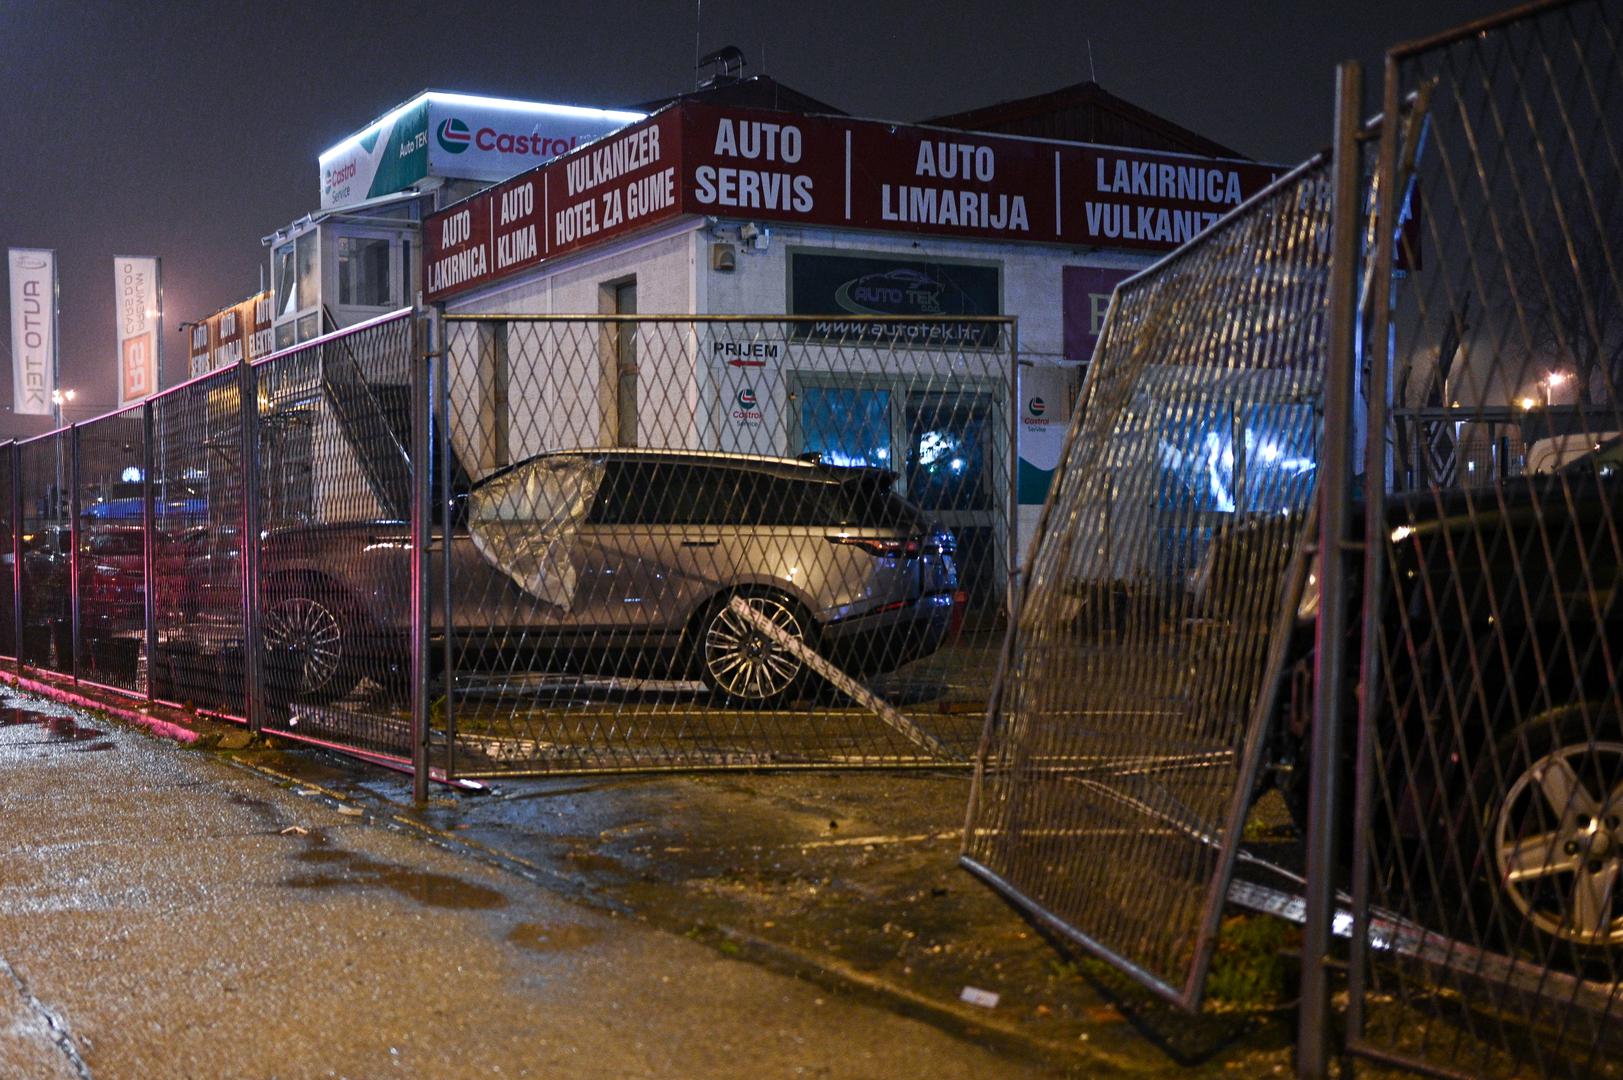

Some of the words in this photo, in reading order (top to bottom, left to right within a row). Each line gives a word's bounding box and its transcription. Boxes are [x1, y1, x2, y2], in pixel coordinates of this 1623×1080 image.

[400, 140, 415, 158] Auto
[415, 130, 428, 150] TEK
[566, 124, 660, 197] VULKANIZER
[714, 118, 802, 164] AUTO
[916, 141, 995, 183] AUTO
[332, 159, 357, 188] Castrol
[695, 165, 814, 213] SERVIS
[1096, 157, 1243, 205] LAKIRNICA
[500, 182, 534, 227] AUTO
[556, 198, 600, 247] HOTEL
[603, 188, 624, 230] ZA
[627, 166, 675, 221] GUME
[882, 184, 1030, 232] LIMARIJA
[442, 209, 471, 251] AUTO
[498, 224, 538, 270] KLIMA
[428, 243, 488, 294] LAKIRNICA
[855, 287, 903, 303] AUTO
[905, 289, 941, 307] TEK
[713, 342, 778, 358] PRIJEM
[1024, 417, 1050, 425] Castrol
